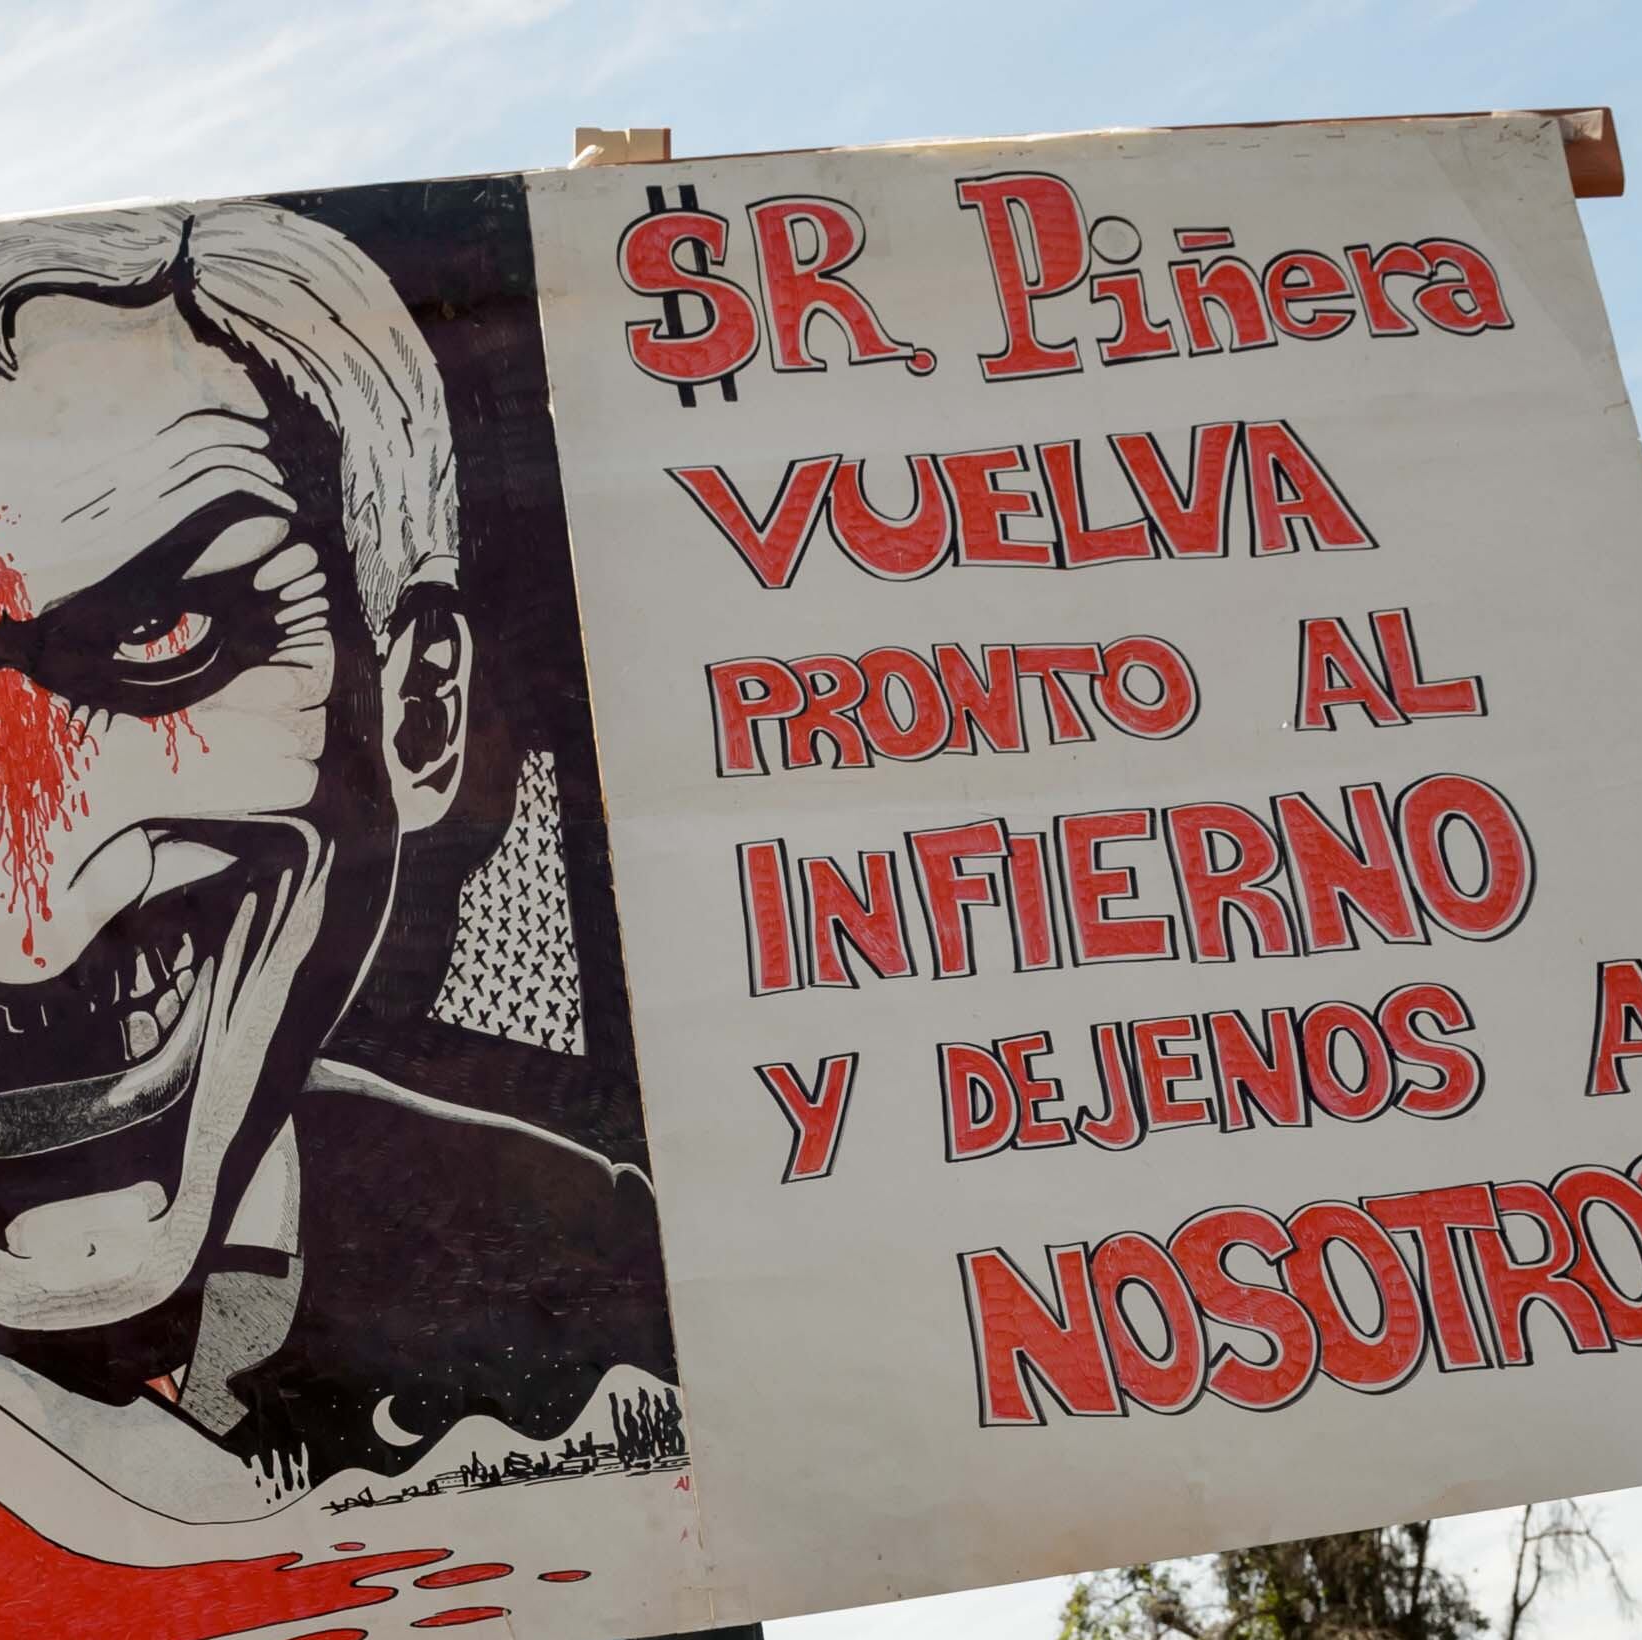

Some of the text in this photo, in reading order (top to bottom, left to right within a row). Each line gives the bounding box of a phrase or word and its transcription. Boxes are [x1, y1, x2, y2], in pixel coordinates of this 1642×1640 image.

[957, 171, 1514, 381] Piñera
[666, 418, 1379, 588] VUELVA
[706, 606, 1488, 777] PRONTO AL
[735, 773, 1537, 997] INFIERNO
[756, 1051, 859, 1184] Y
[939, 982, 1487, 1163] DEJENOS
